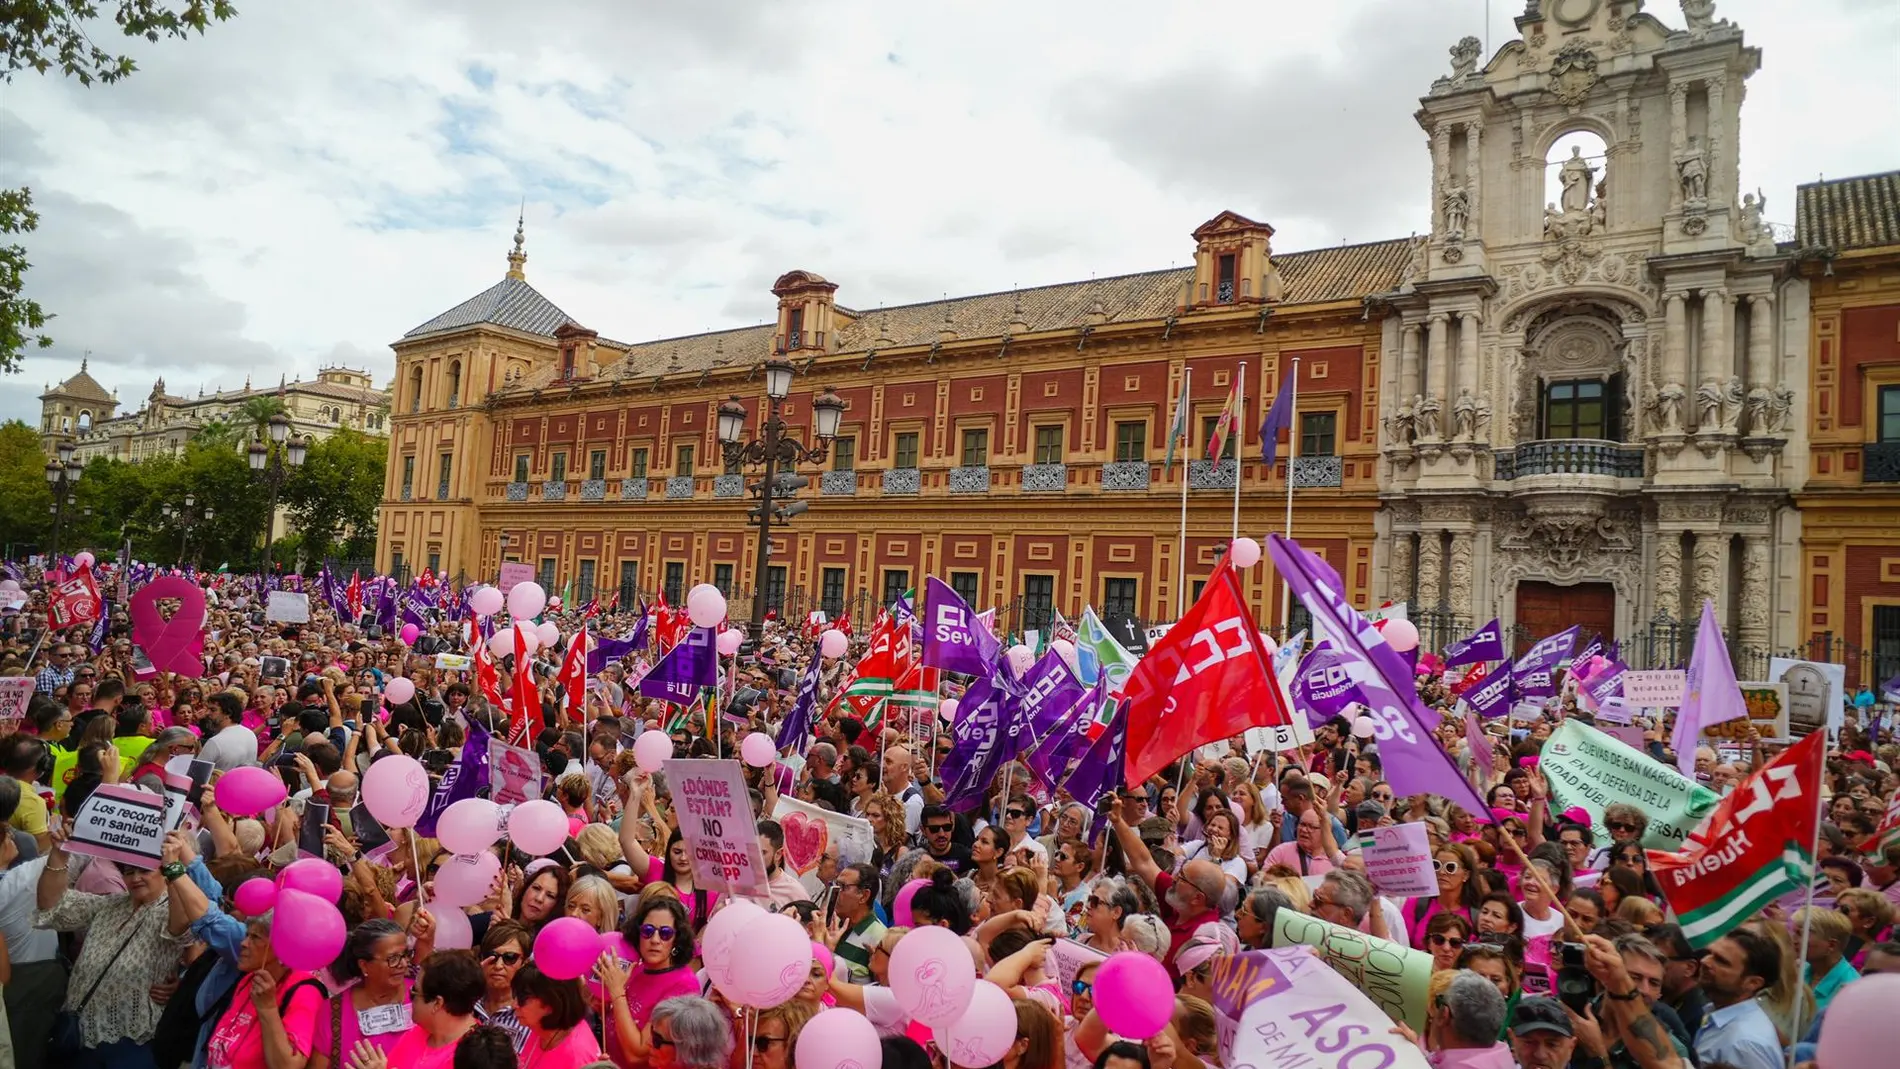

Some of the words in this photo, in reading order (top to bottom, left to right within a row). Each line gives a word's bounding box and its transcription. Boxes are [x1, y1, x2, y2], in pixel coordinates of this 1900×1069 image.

[1577, 741, 1609, 762] CUEVAS
[1610, 752, 1622, 766] DE
[1622, 757, 1641, 774] SAN
[1643, 763, 1687, 792] MARCOS
[682, 776, 731, 798] ¿DÓNDE
[1568, 758, 1588, 771] EN
[1587, 768, 1601, 781] LA
[1602, 773, 1641, 800] DEFENSA
[1642, 788, 1658, 806] DE
[1657, 795, 1671, 811] LA
[92, 801, 116, 815] Los
[687, 797, 732, 817] ESTÁN?
[90, 815, 106, 827] en
[108, 819, 158, 838] sanidad
[701, 818, 723, 837] NO
[100, 831, 140, 847] matan
[696, 847, 749, 866] CRIBADOS
[723, 867, 741, 881] PP
[1255, 1021, 1286, 1046] DE
